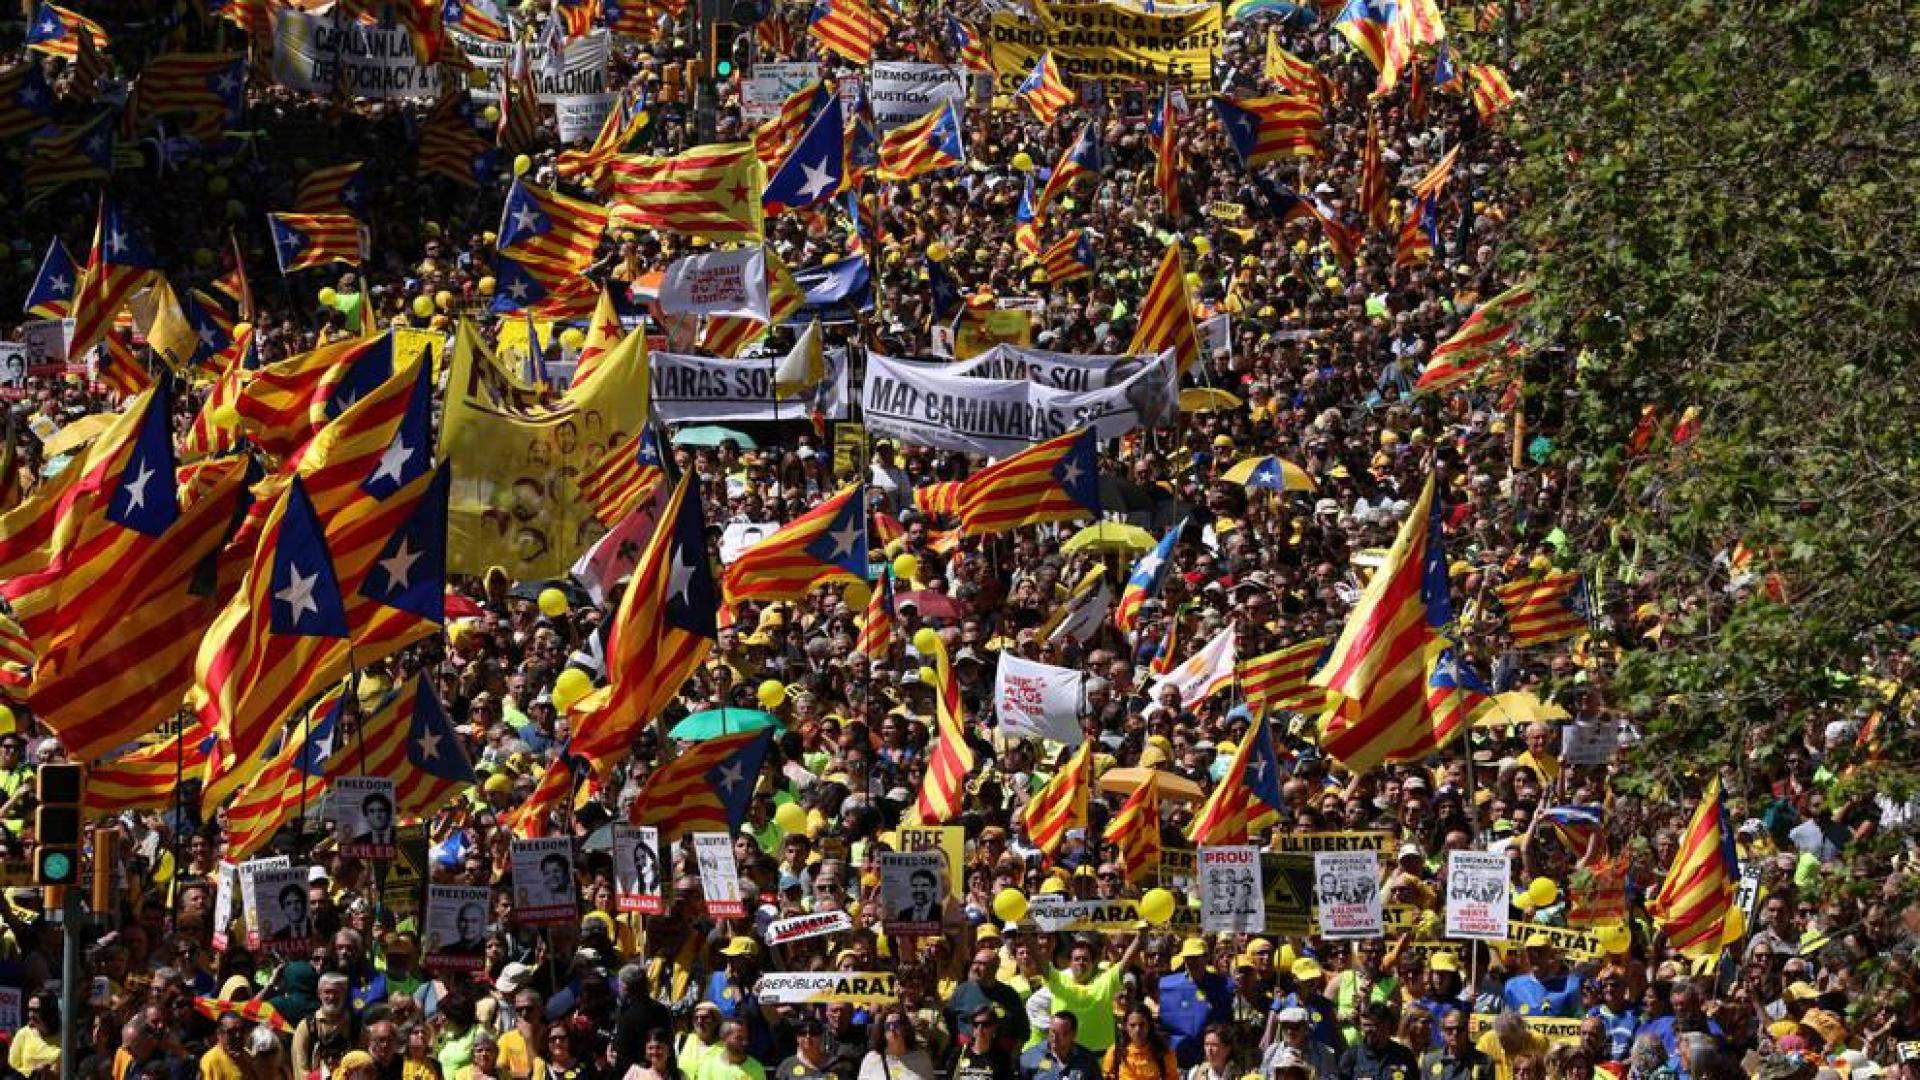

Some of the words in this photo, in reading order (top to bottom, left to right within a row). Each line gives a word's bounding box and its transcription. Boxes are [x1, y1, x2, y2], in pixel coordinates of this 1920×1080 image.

[901, 829, 944, 852] FREE
[1281, 835, 1385, 852] LLIBERTAT
[1034, 902, 1088, 919] PÚBLICA
[1091, 904, 1140, 922] ARA
[1508, 922, 1599, 953] LIBERTAT
[835, 975, 896, 997] ARA!
